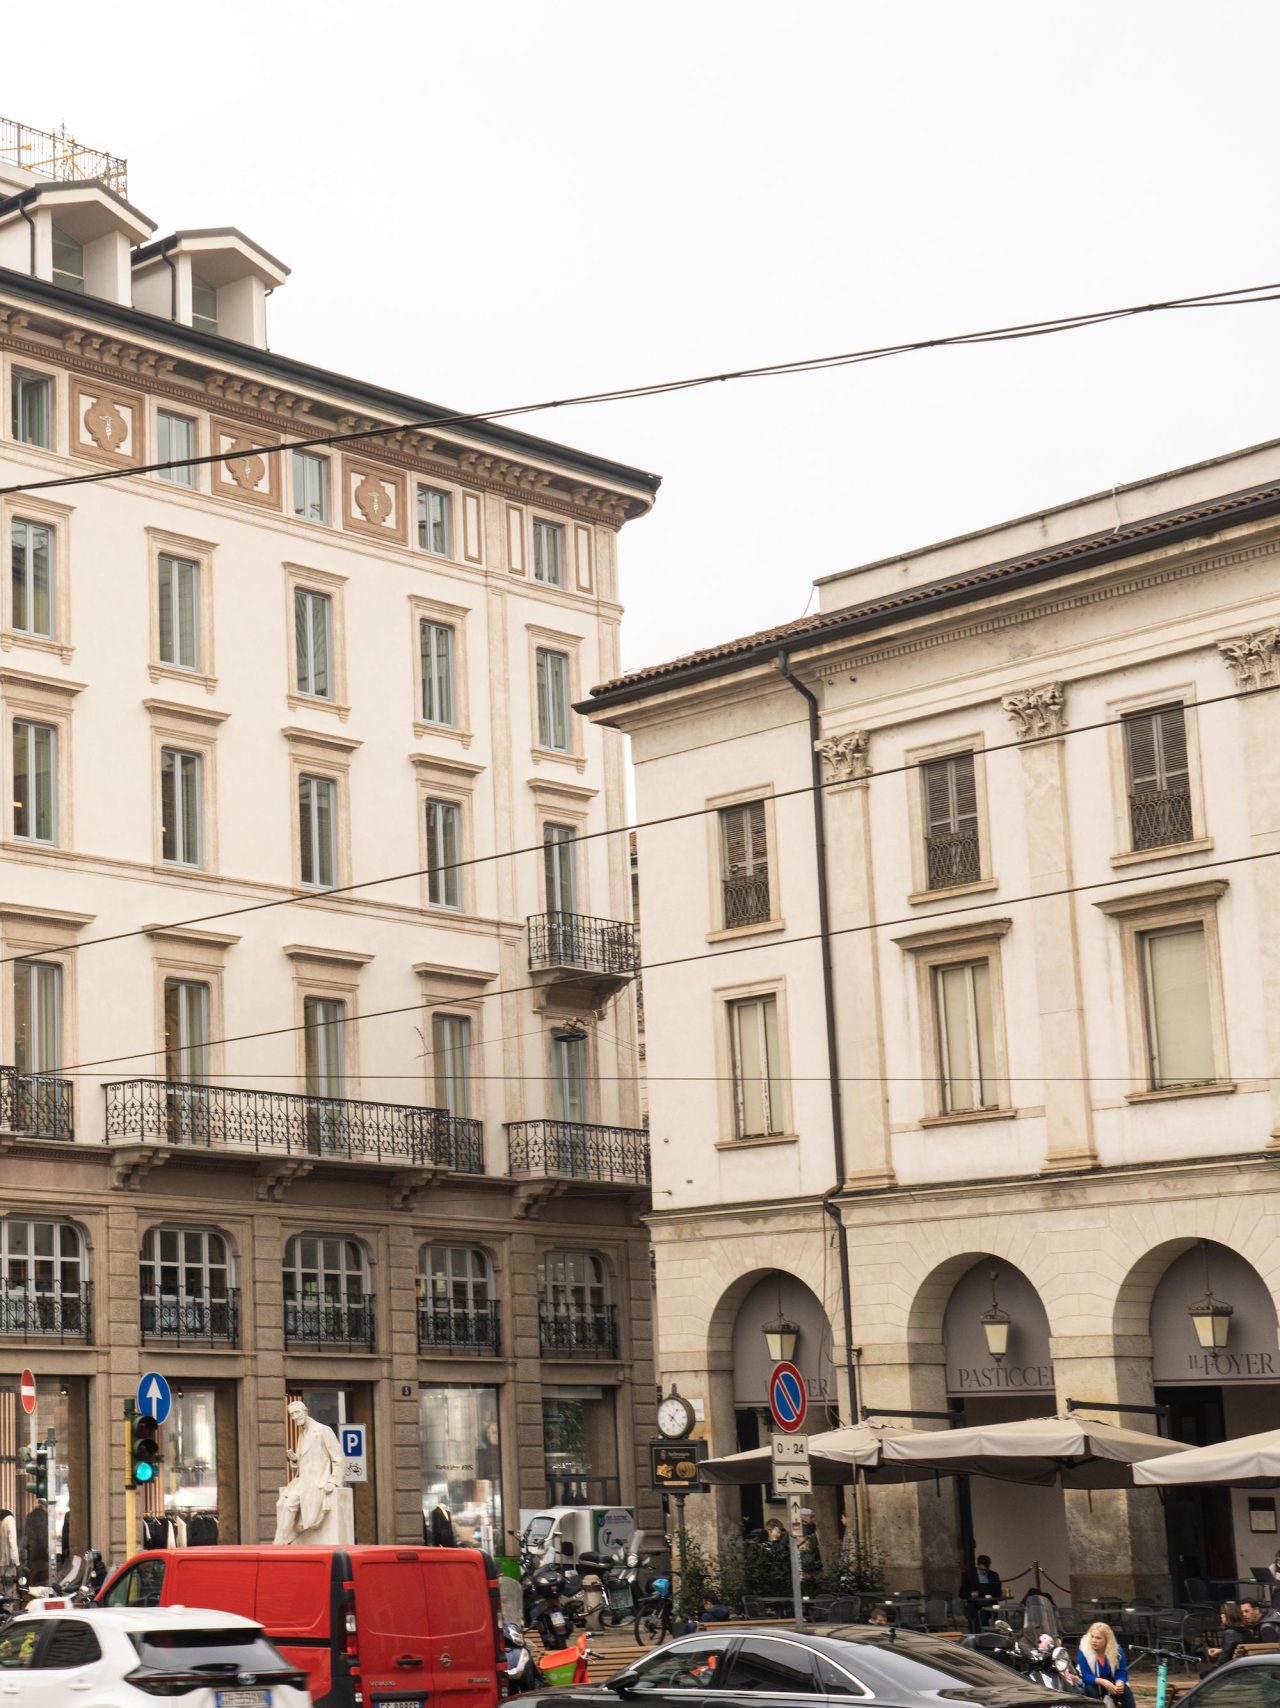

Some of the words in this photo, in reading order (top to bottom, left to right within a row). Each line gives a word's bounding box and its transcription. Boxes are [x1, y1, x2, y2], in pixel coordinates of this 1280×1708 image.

[1188, 1354, 1203, 1369] IL
[1203, 1353, 1275, 1375] FOYER
[346, 1433, 359, 1454] P
[793, 1443, 804, 1454] 24
